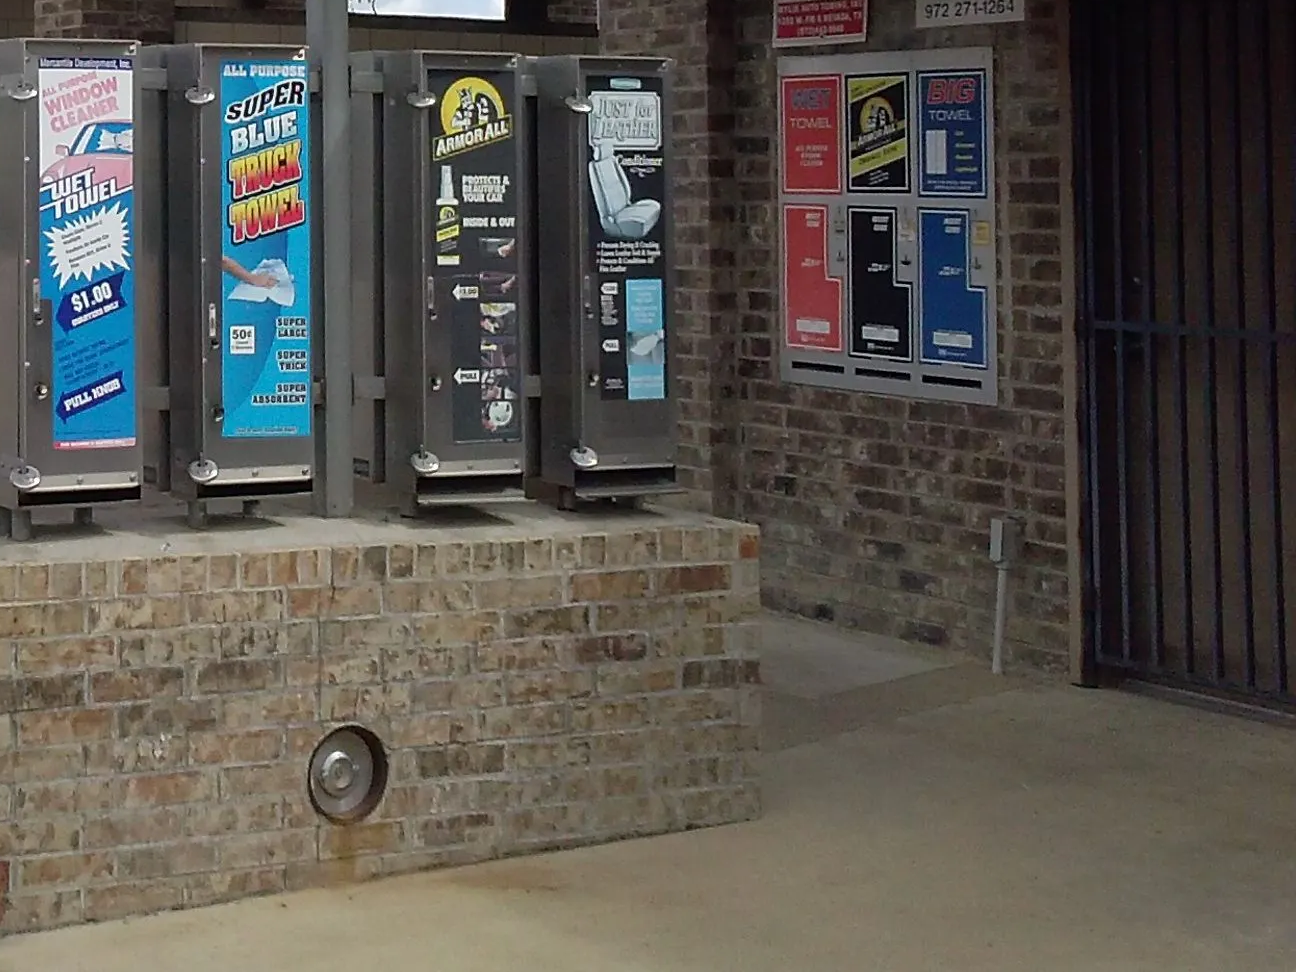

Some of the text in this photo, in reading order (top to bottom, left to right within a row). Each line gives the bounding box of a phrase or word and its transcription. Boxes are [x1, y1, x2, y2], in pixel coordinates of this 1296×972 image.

[924, 4, 949, 19] 972
[223, 64, 306, 77] ALL PURPOSE
[43, 76, 119, 116] WINDOW
[927, 78, 976, 104] BIG
[226, 80, 306, 122] SUPER
[595, 98, 631, 119] JUST
[49, 96, 119, 133] CLEANER
[791, 117, 832, 129] TOWEL
[928, 109, 973, 121] TOWEL
[230, 111, 298, 154] BLUE
[229, 140, 303, 198] TRUCK
[48, 167, 95, 200] WET
[53, 177, 119, 219] TOWEL
[229, 186, 304, 243] TOWEL
[498, 217, 515, 227] OUT
[70, 281, 113, 312] $1.00
[277, 317, 307, 327] SUPER
[232, 329, 253, 340] 50¢
[278, 329, 307, 338] LARGE
[277, 350, 307, 360] SUPER
[279, 362, 307, 371] THICK
[277, 383, 307, 393] SUPER
[63, 390, 93, 412] PULL
[252, 394, 307, 405] ABSORBENT
